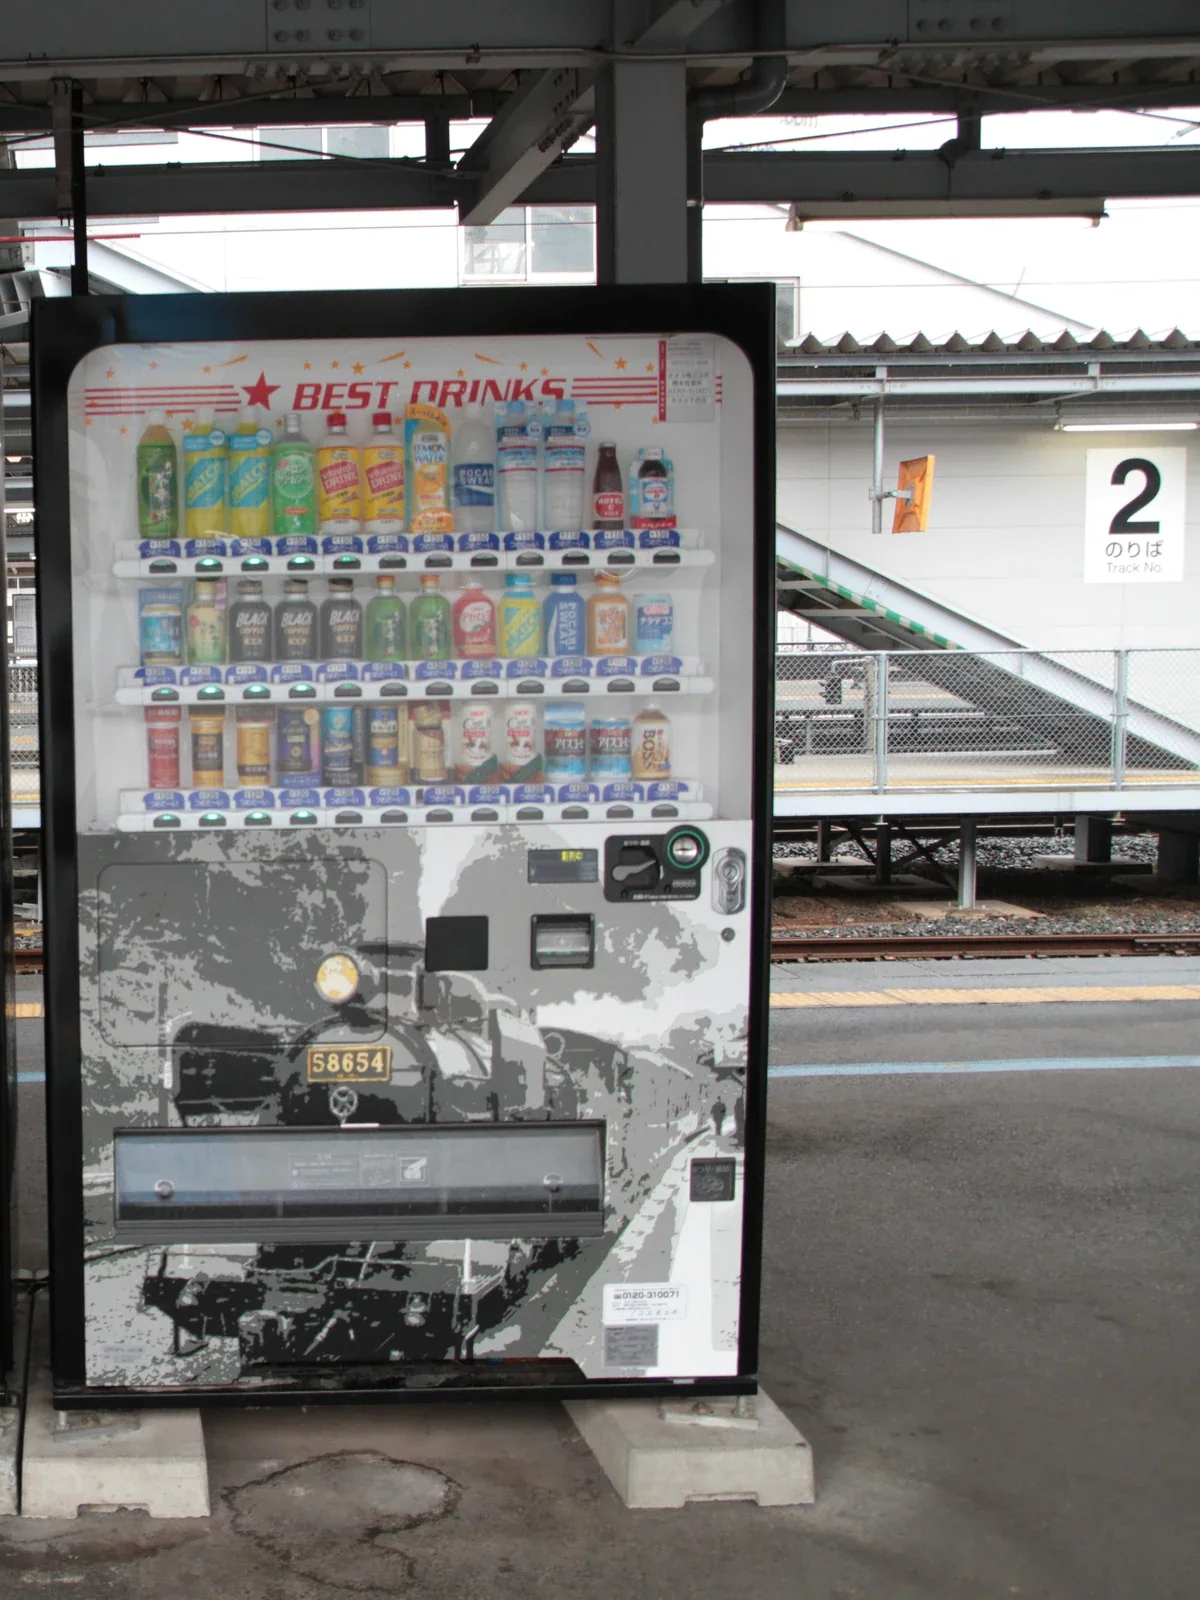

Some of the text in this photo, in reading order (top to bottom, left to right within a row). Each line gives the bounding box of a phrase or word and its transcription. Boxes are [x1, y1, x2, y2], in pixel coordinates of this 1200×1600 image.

[292, 378, 568, 411] BEST DRINKS
[414, 444, 446, 453] LEMON
[414, 454, 445, 464] WATER
[1108, 457, 1162, 535] 2
[1105, 539, 1164, 558] のりば
[1106, 562, 1164, 573] Track No.
[236, 612, 268, 628] BLACK
[281, 612, 313, 628] BLACK
[329, 610, 360, 626] BLACK
[559, 602, 569, 646] SWEAT
[568, 602, 577, 651] POCARI
[642, 729, 656, 771] BOSS
[312, 1051, 385, 1073] 58654
[622, 1290, 680, 1299] 0120-310071
